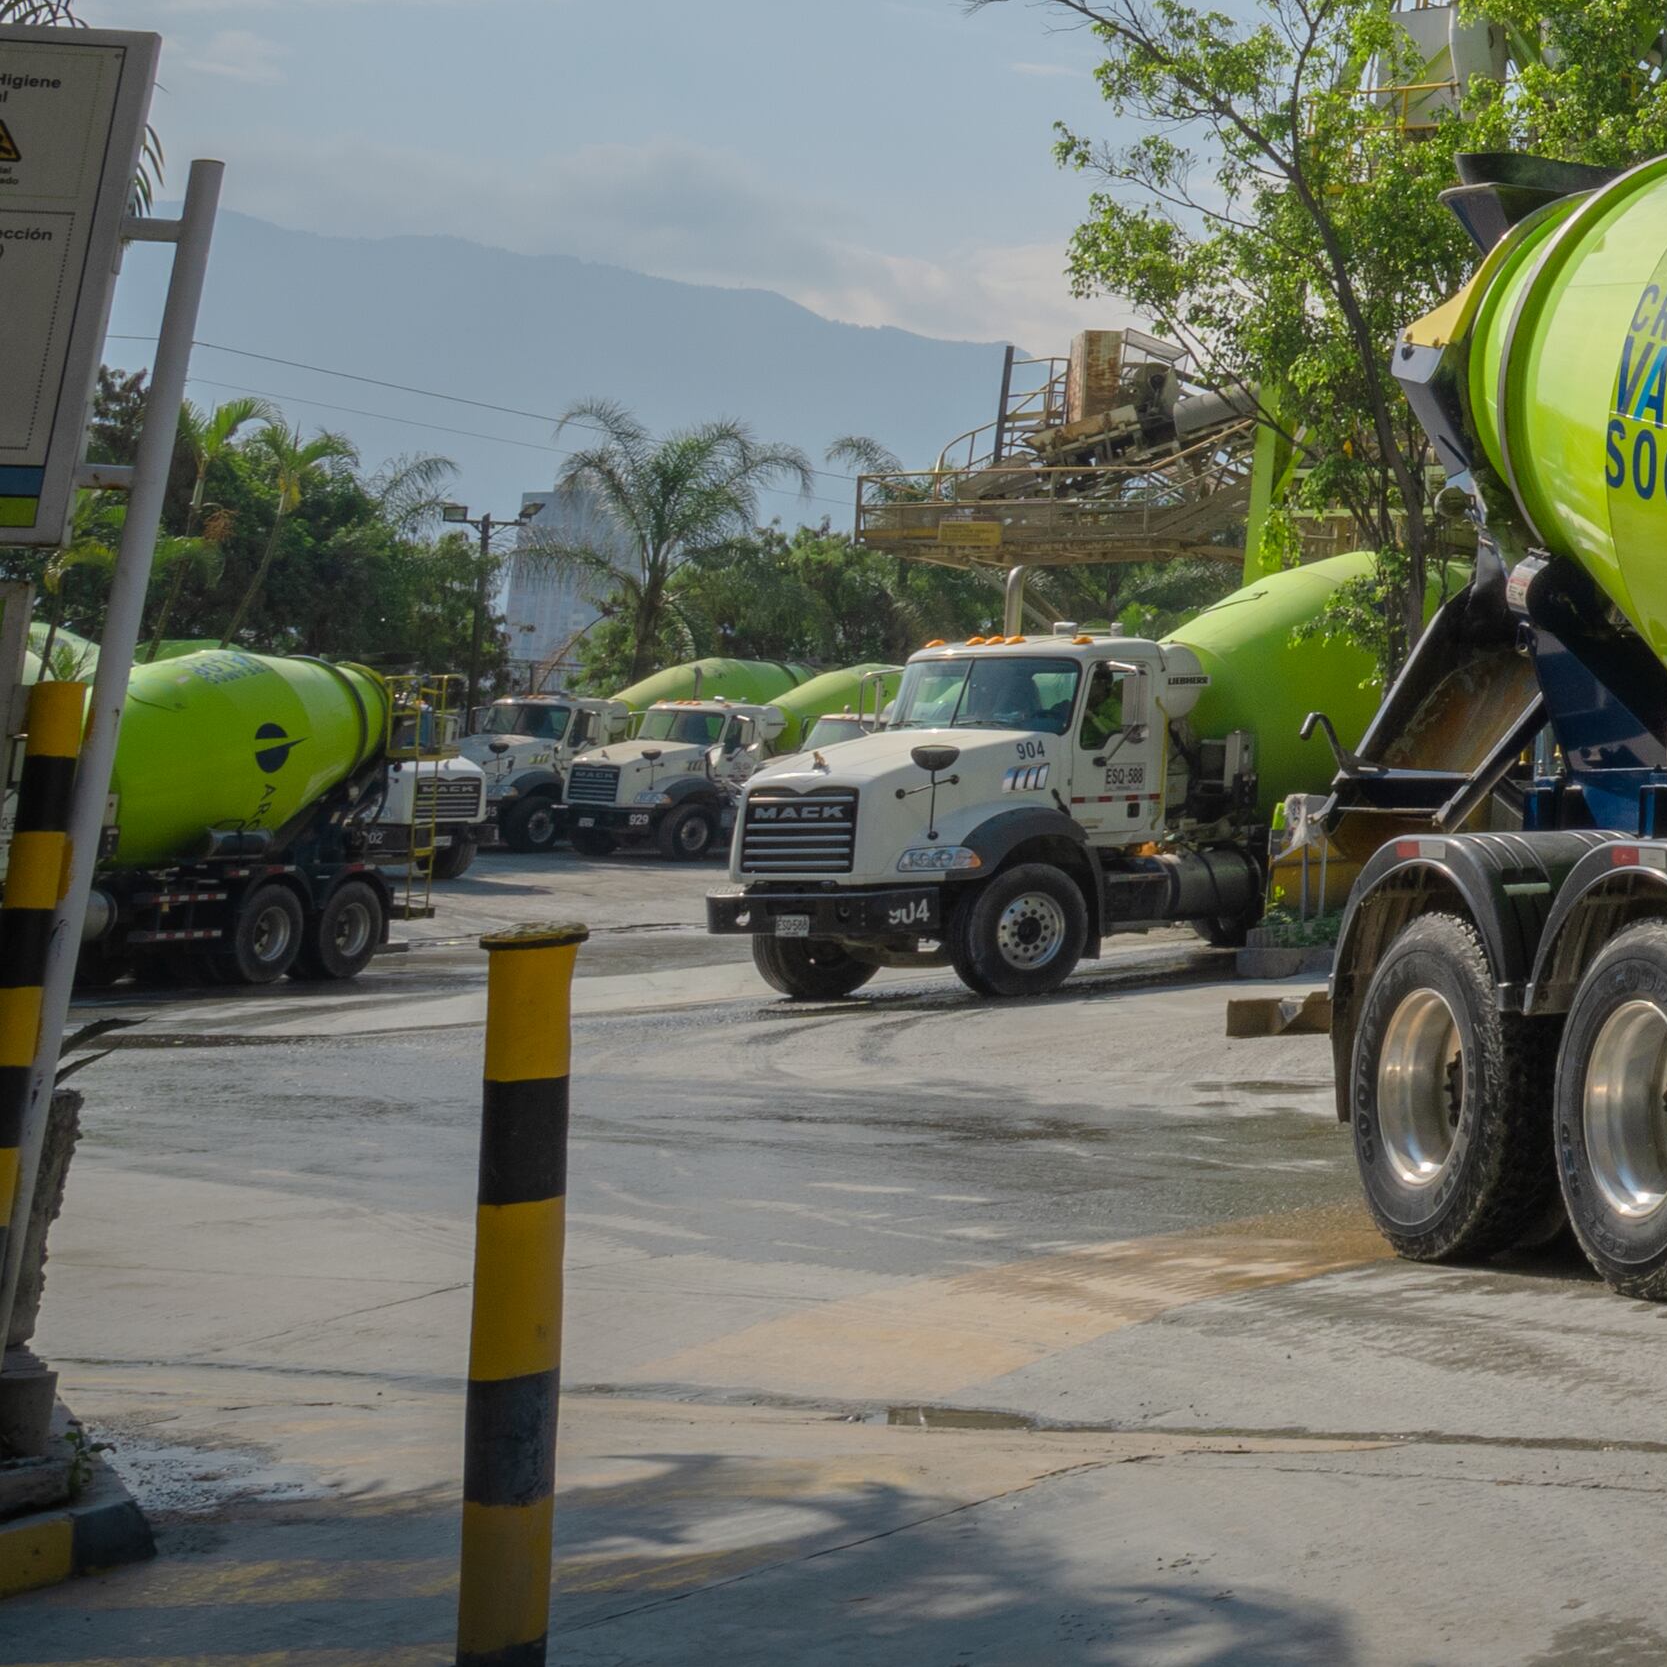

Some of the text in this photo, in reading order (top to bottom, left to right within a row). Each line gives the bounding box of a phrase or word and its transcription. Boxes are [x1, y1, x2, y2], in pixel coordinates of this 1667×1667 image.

[0, 227, 52, 241] cción
[1016, 740, 1045, 760] 904
[754, 806, 844, 819] MACK
[629, 814, 649, 825] 929
